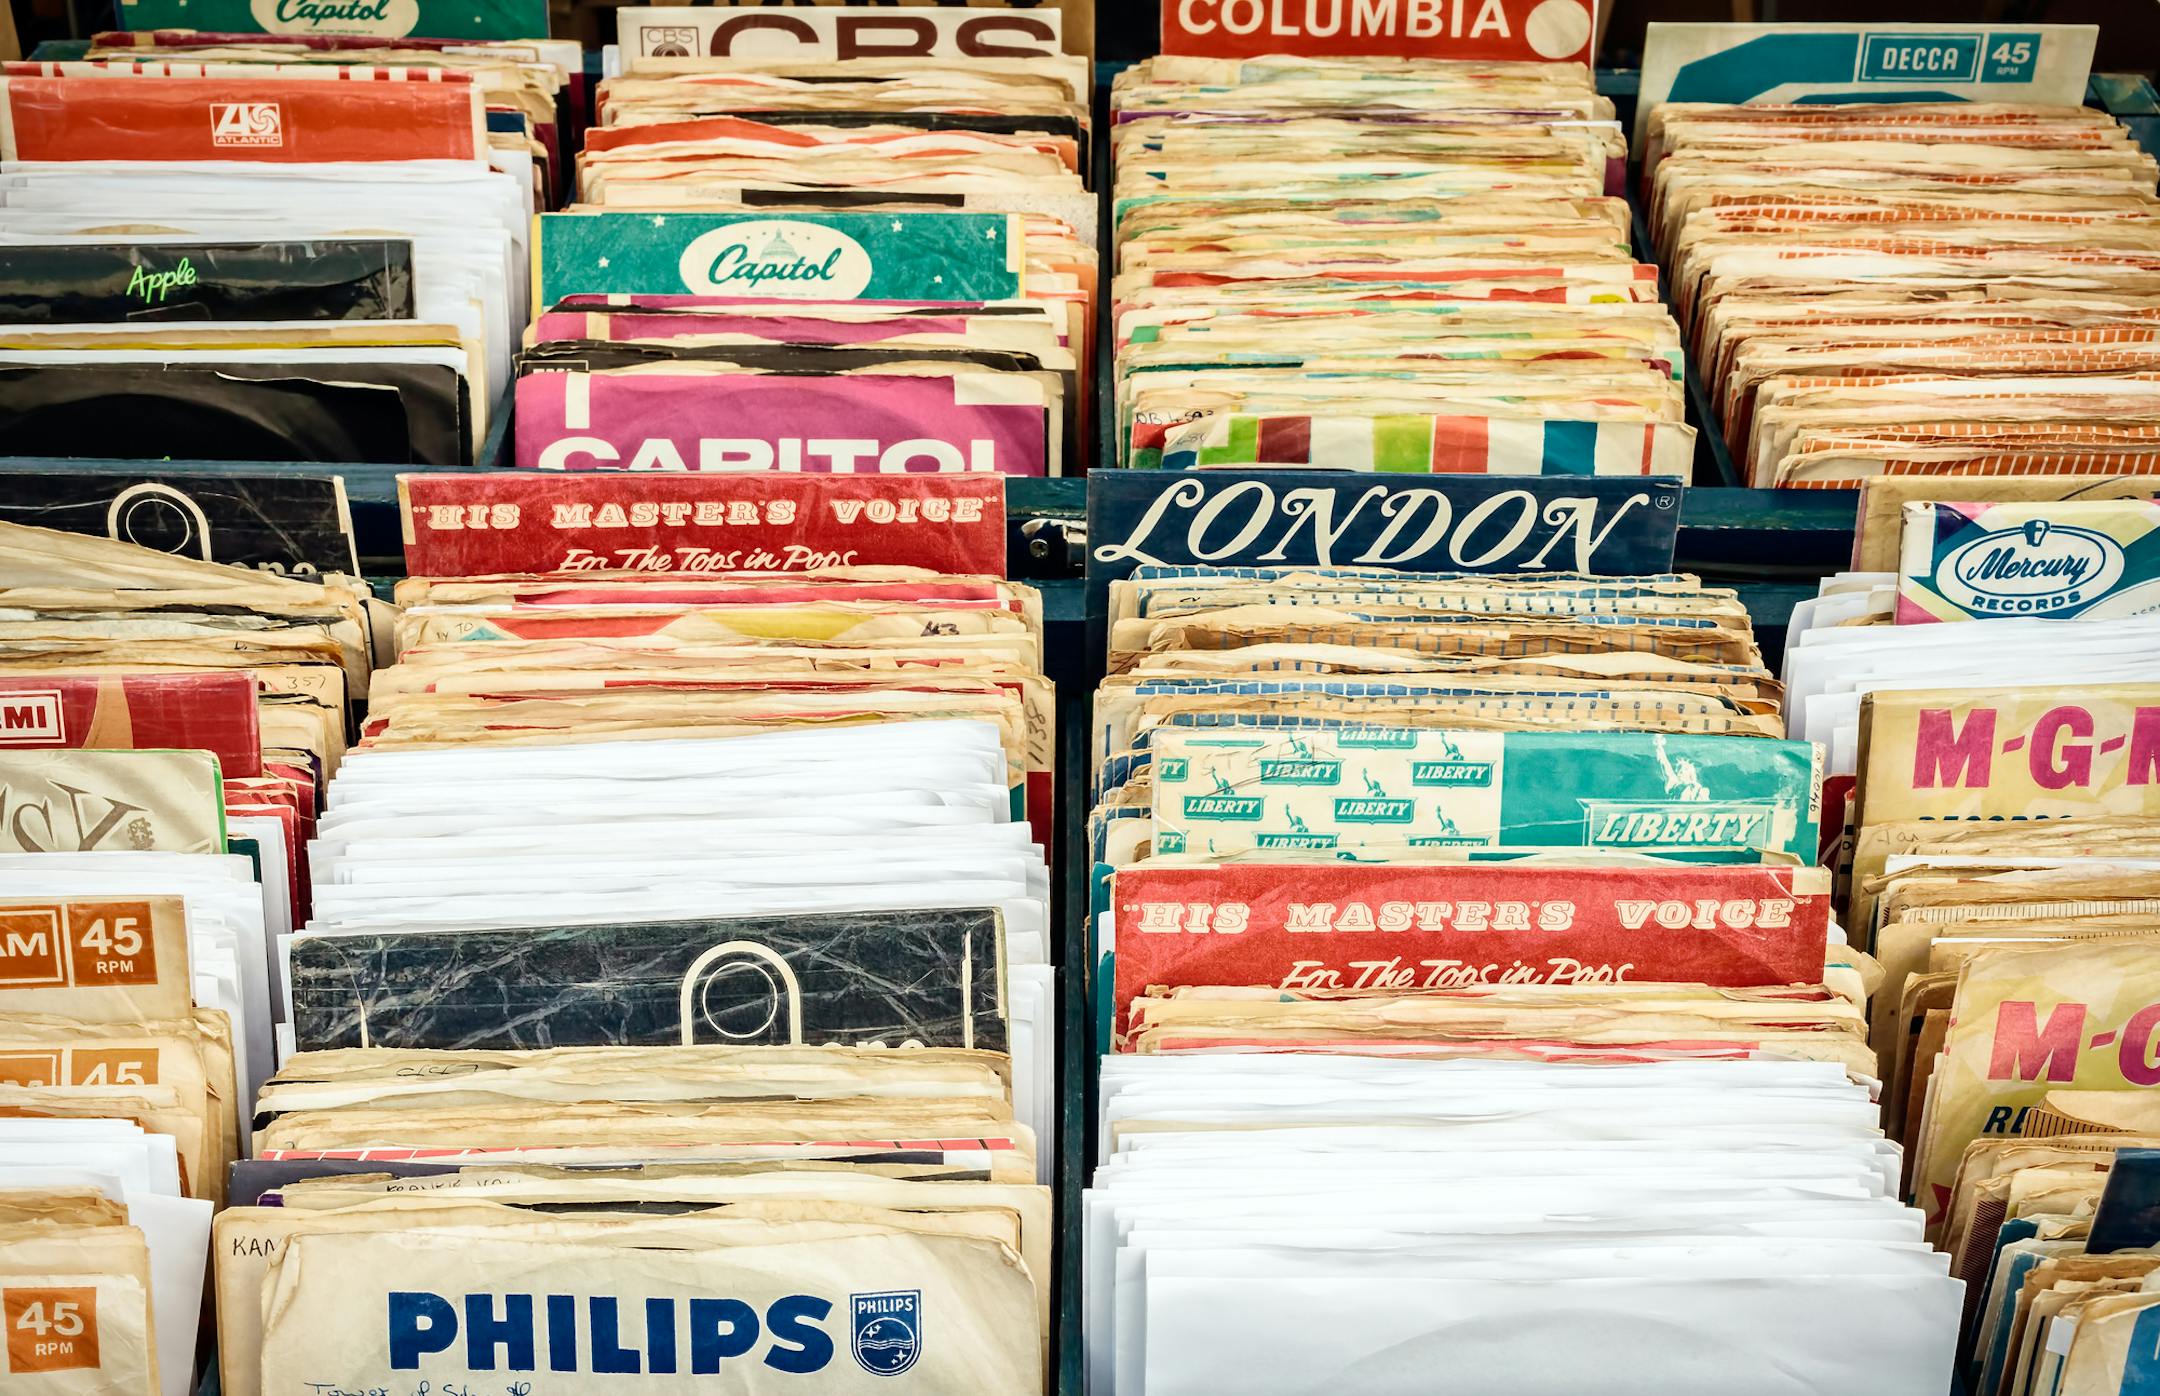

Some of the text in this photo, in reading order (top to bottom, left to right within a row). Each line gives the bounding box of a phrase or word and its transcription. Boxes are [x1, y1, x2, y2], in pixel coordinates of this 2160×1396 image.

[275, 0, 389, 26] Capitol
[1178, 0, 1511, 39] COLUMBIA
[647, 29, 693, 44] CBS
[1882, 47, 1959, 70] DECCA
[1991, 42, 2031, 64] 45
[1996, 67, 2019, 75] RPM
[217, 136, 279, 144] ATLANTIC
[708, 244, 842, 288] Capitol
[126, 257, 196, 303] Apple
[551, 500, 797, 528] MASTER'S
[1094, 478, 1649, 575] LONDON
[558, 549, 612, 572] For
[614, 545, 673, 572] The
[675, 547, 742, 572] Tops
[744, 547, 780, 570] in
[1966, 547, 2090, 585] Mercury
[1972, 591, 2081, 612] RECORDS
[1265, 763, 1335, 779] LIBERTY
[1415, 765, 1488, 780] LIBERTY
[1186, 799, 1259, 815] LIBERTY
[1337, 801, 1410, 817] LIBERTY
[1595, 813, 1765, 842] LIBERTY
[1261, 837, 1335, 848] LIBERTY
[1284, 900, 1576, 932] MASTER'S
[80, 918, 143, 956] 45
[97, 960, 134, 974] RPM
[1279, 960, 1345, 989] For
[1348, 956, 1415, 989] The
[1499, 960, 1543, 985] in
[82, 1061, 145, 1086] 45
[857, 1297, 914, 1315] PHILIPS
[16, 1302, 84, 1336] 45
[388, 1291, 834, 1375] PHILIPS
[35, 1342, 73, 1356] RPM
